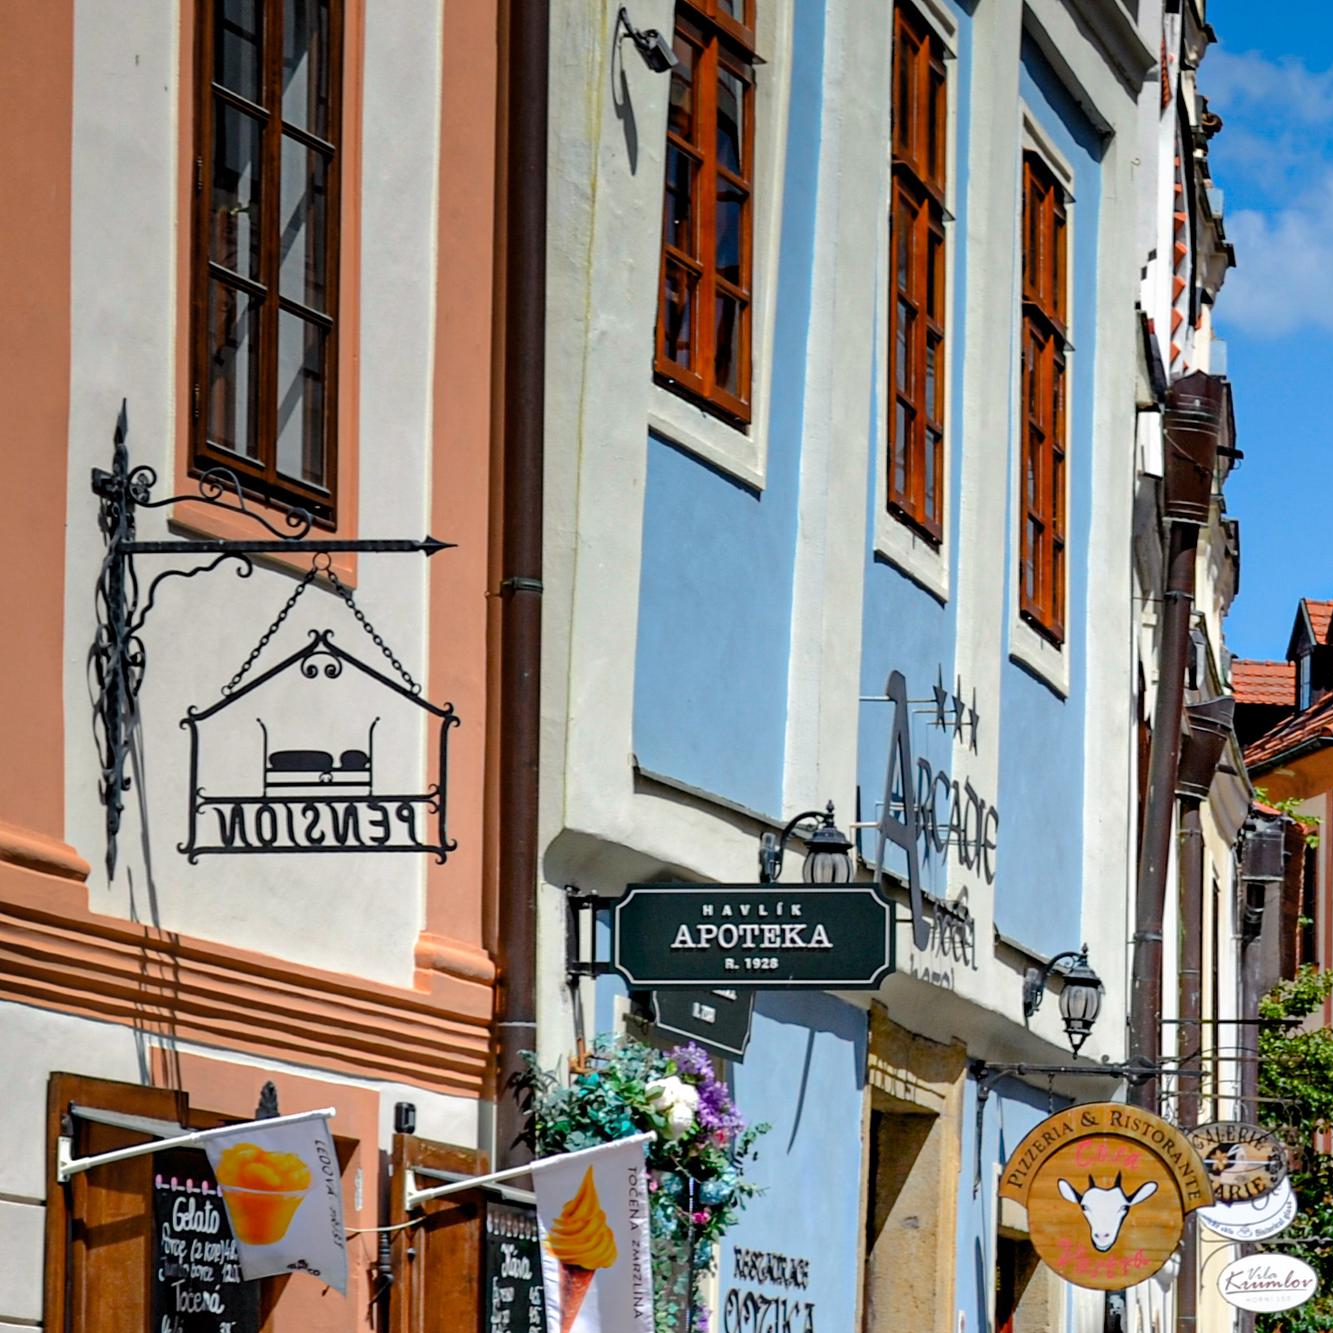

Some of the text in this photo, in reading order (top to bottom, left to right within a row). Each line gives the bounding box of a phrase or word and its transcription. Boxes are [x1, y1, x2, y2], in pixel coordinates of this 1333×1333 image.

[702, 901, 802, 917] HAVLÍK
[670, 923, 834, 949] APOTEKA
[724, 957, 779, 970] R. 1928
[1007, 1121, 1074, 1189] PIZZERIA
[1080, 1110, 1099, 1127] &
[1110, 1110, 1201, 1202] RISTORANTE
[1212, 1176, 1266, 1201] ARIE
[172, 1197, 220, 1234] Gelato
[1225, 1269, 1313, 1292] Krumlov
